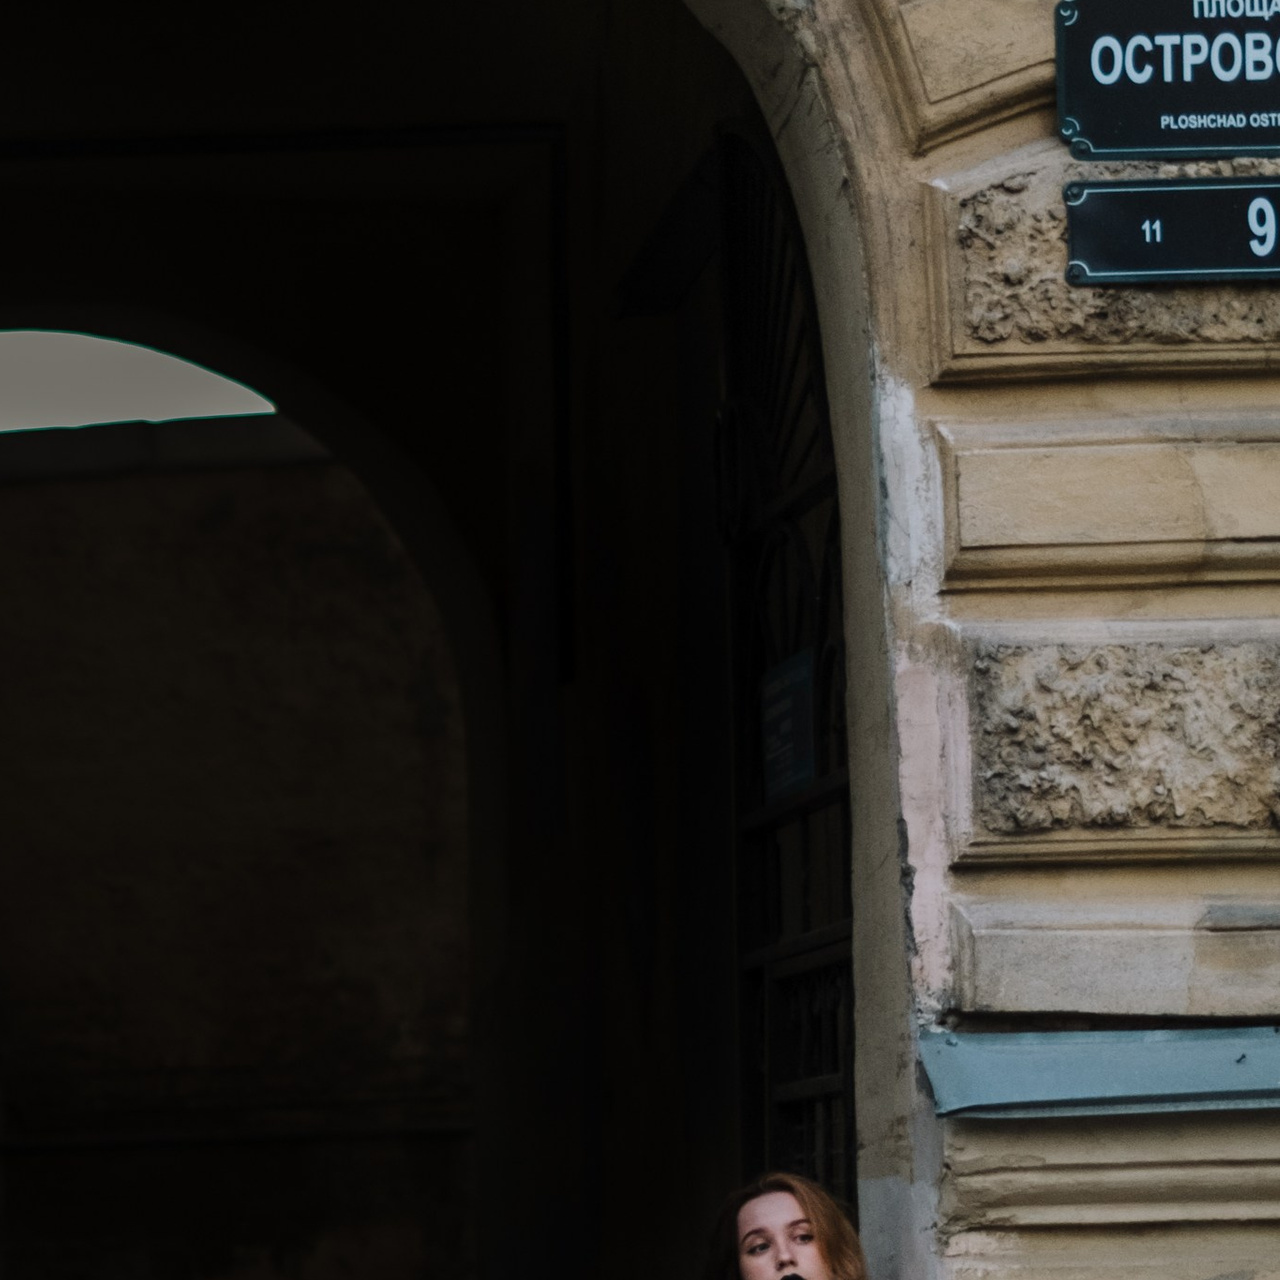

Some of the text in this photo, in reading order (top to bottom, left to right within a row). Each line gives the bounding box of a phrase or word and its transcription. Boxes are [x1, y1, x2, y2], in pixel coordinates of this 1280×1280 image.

[1090, 32, 1280, 85] ОСТРОВ
[1160, 113, 1247, 130] PLOSHCHAD
[1141, 219, 1162, 243] 11
[1247, 197, 1276, 257] 9
